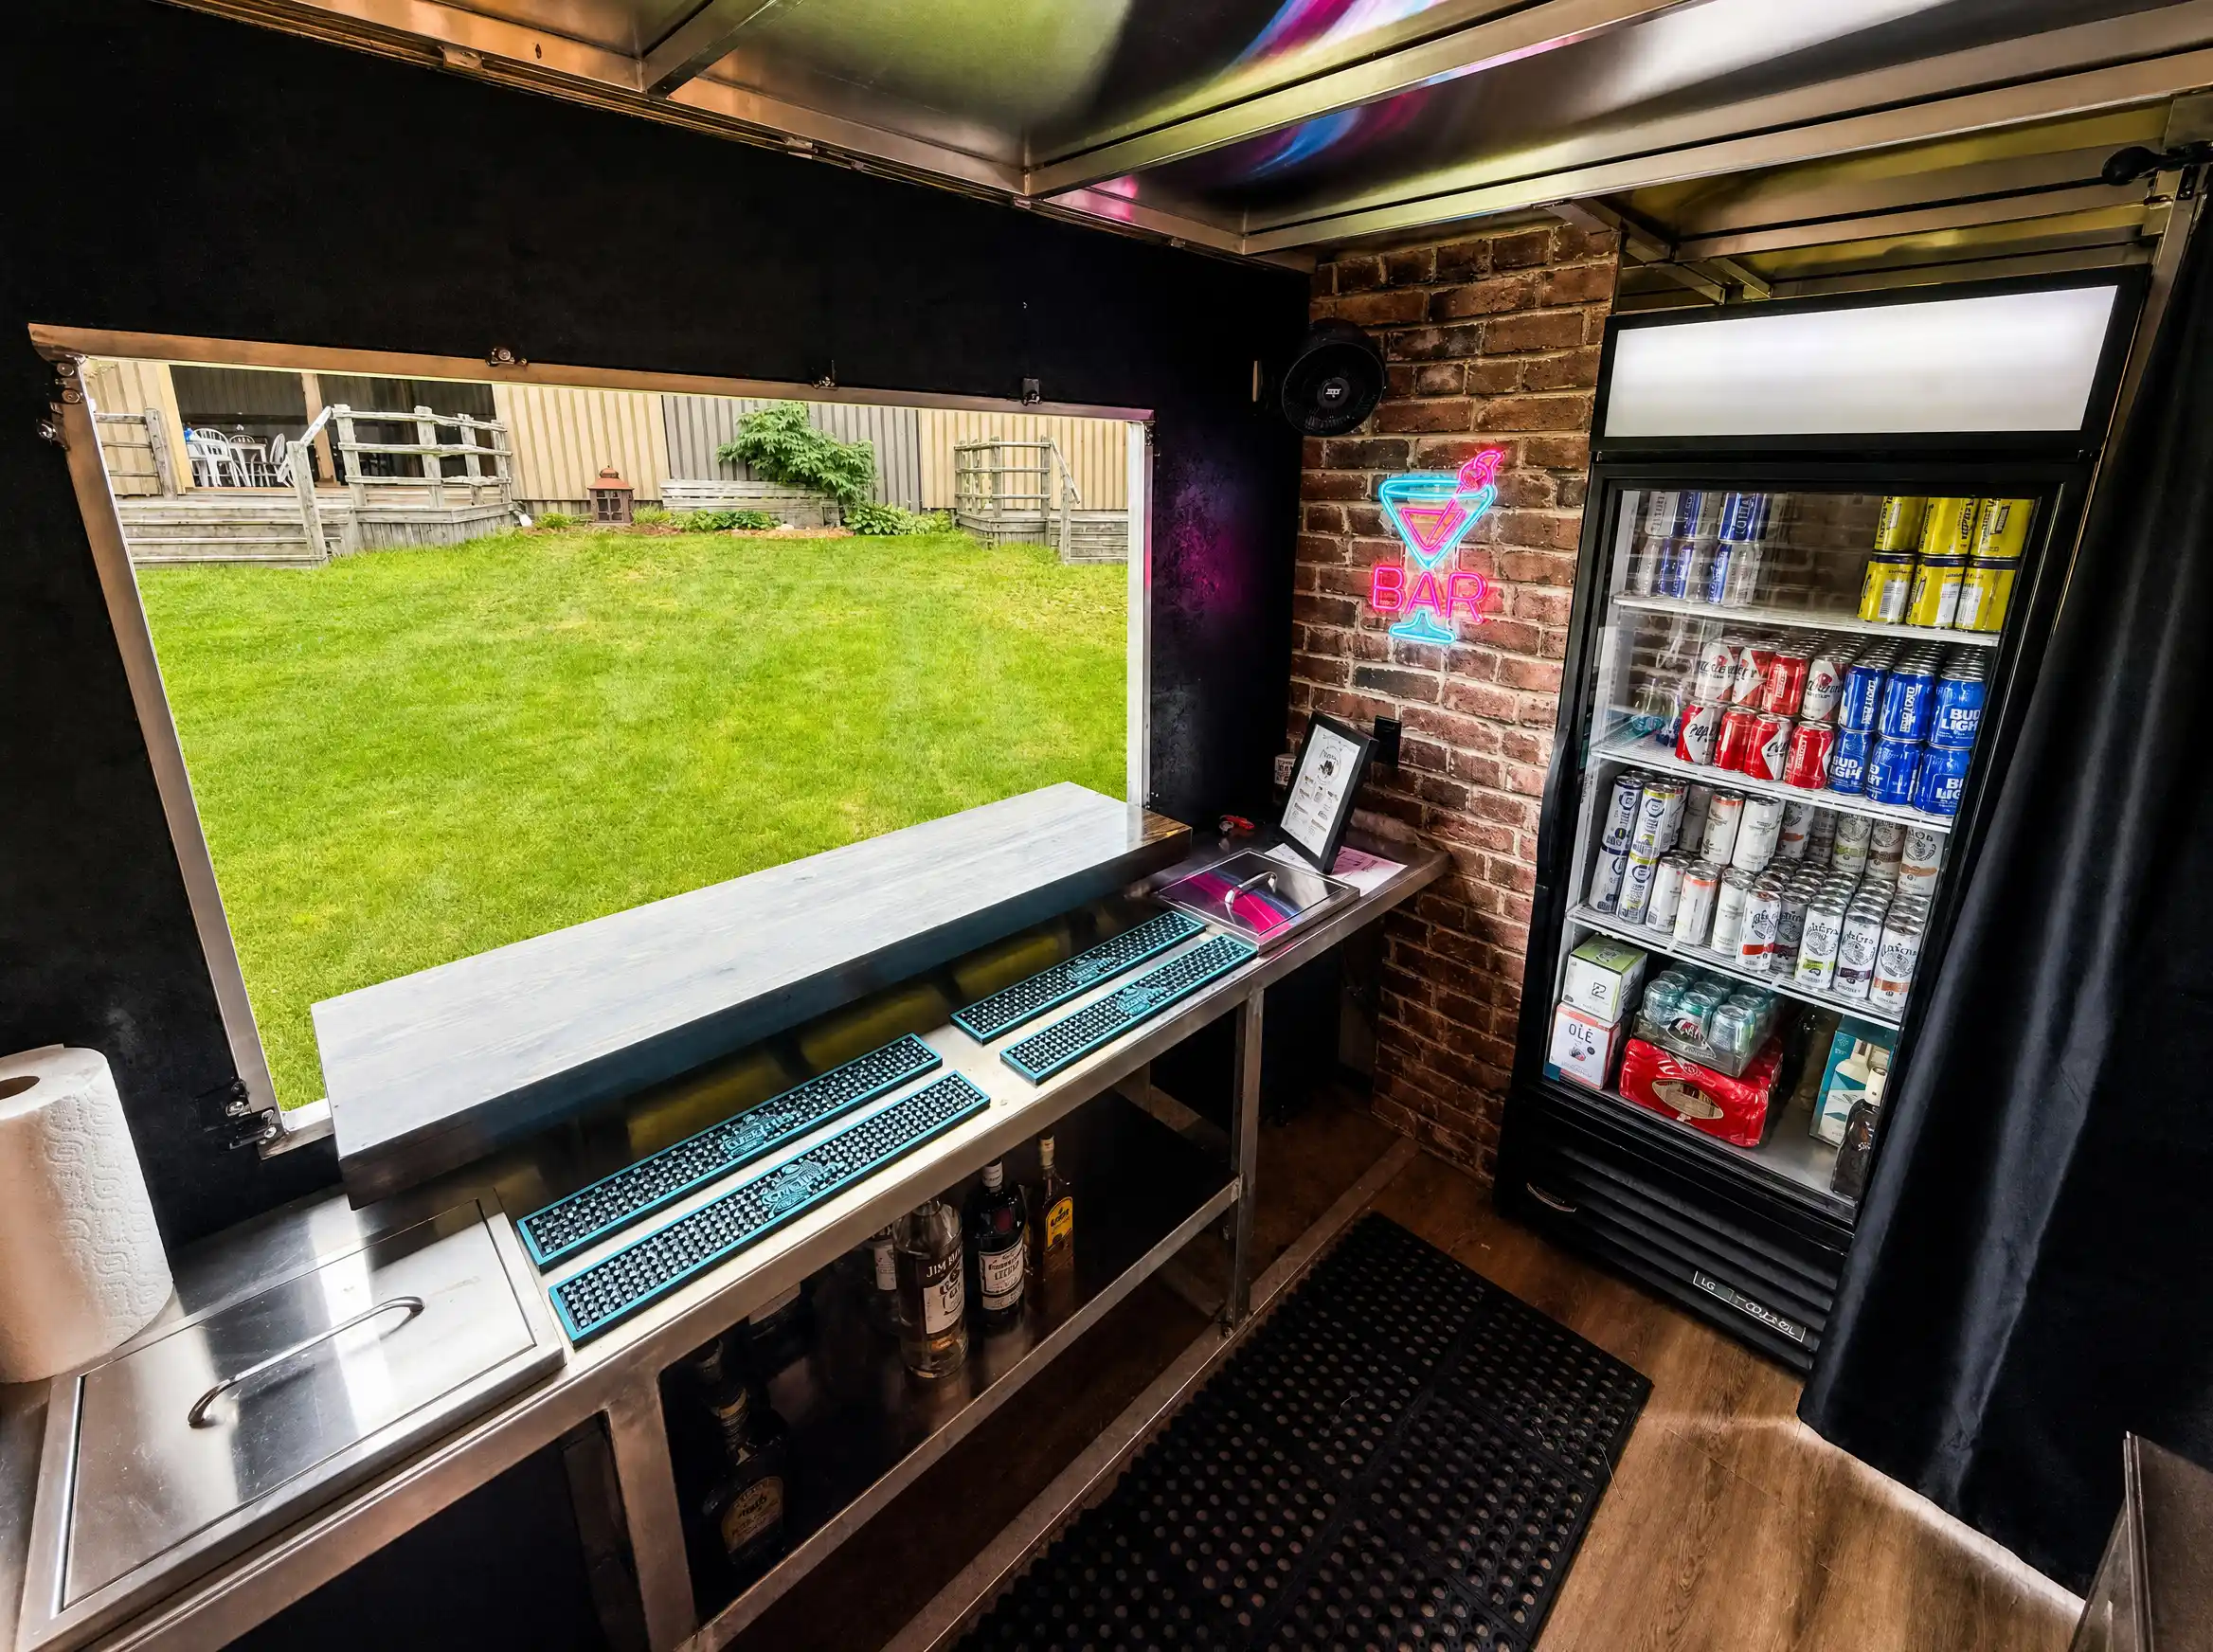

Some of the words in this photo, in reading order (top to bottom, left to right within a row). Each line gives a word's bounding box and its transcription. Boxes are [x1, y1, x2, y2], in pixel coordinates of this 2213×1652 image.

[1373, 566, 1484, 624] BAR
[1949, 708, 1981, 722] BUD
[1941, 718, 1980, 732] LIGH
[926, 1260, 946, 1279] JIM
[1700, 1276, 1717, 1291] LG
